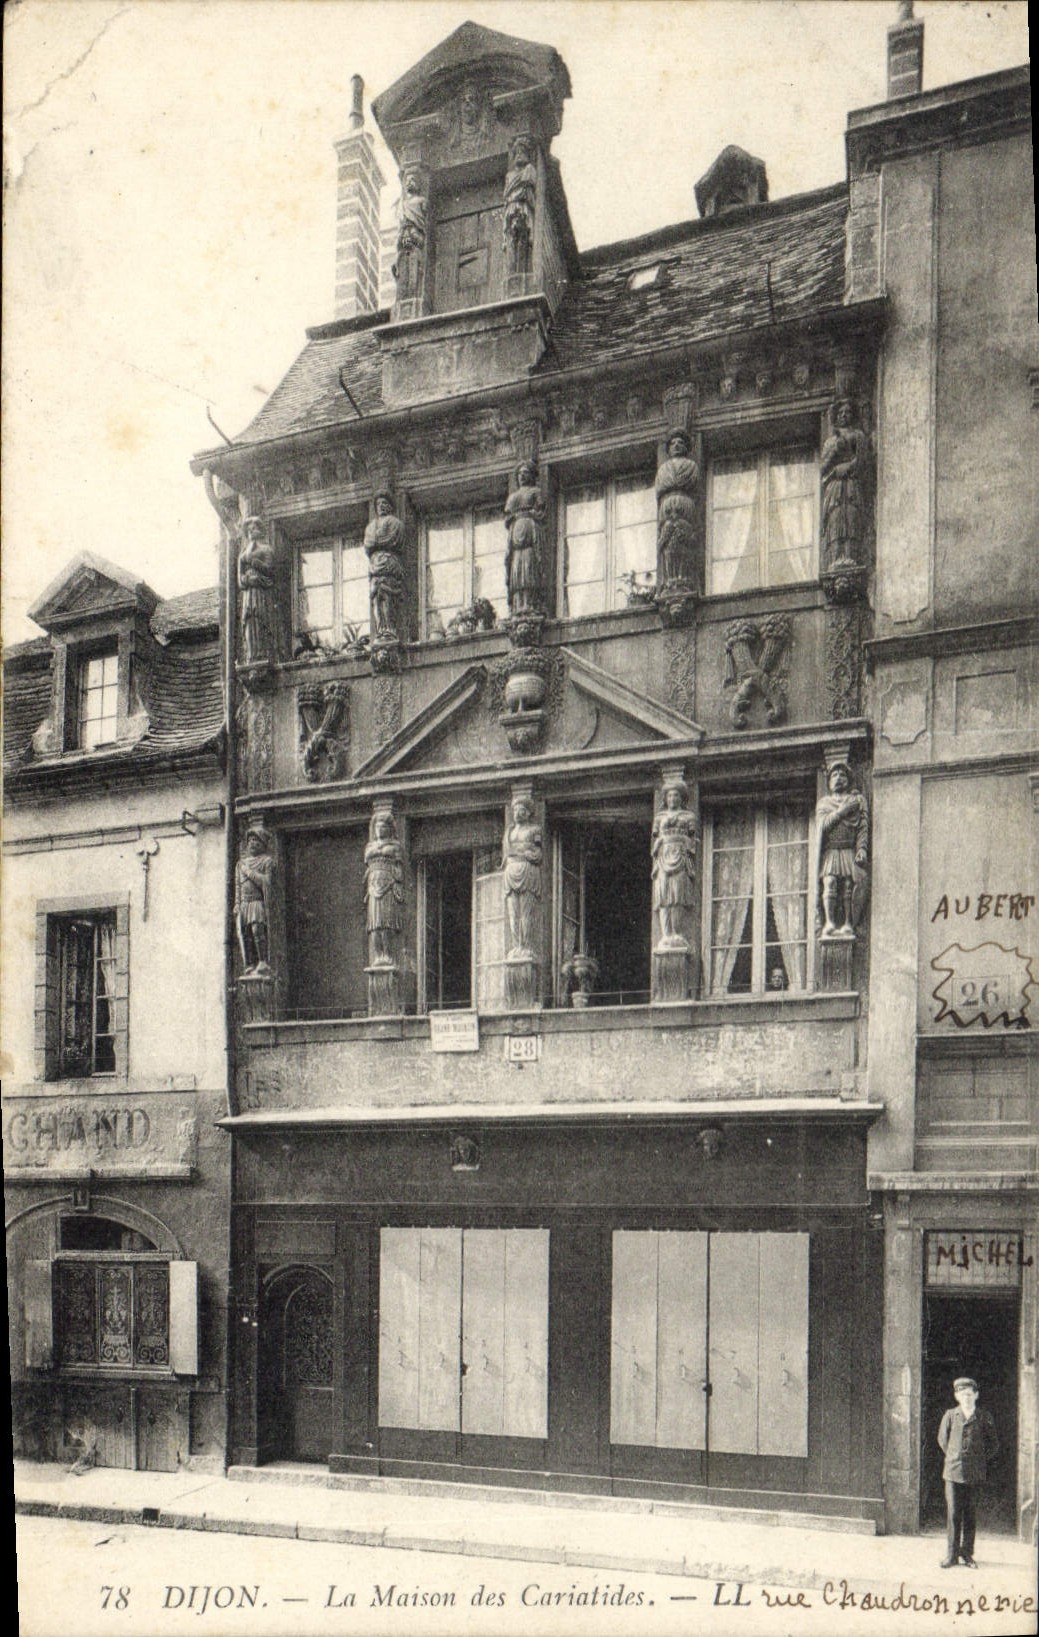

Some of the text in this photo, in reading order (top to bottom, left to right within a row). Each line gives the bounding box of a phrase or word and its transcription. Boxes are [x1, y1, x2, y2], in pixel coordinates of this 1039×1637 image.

[931, 892, 1036, 923] AUBERT
[960, 981, 999, 1007] 26
[512, 1041, 535, 1057] 28
[761, 1580, 1038, 1616] rue Chaudronnerie
